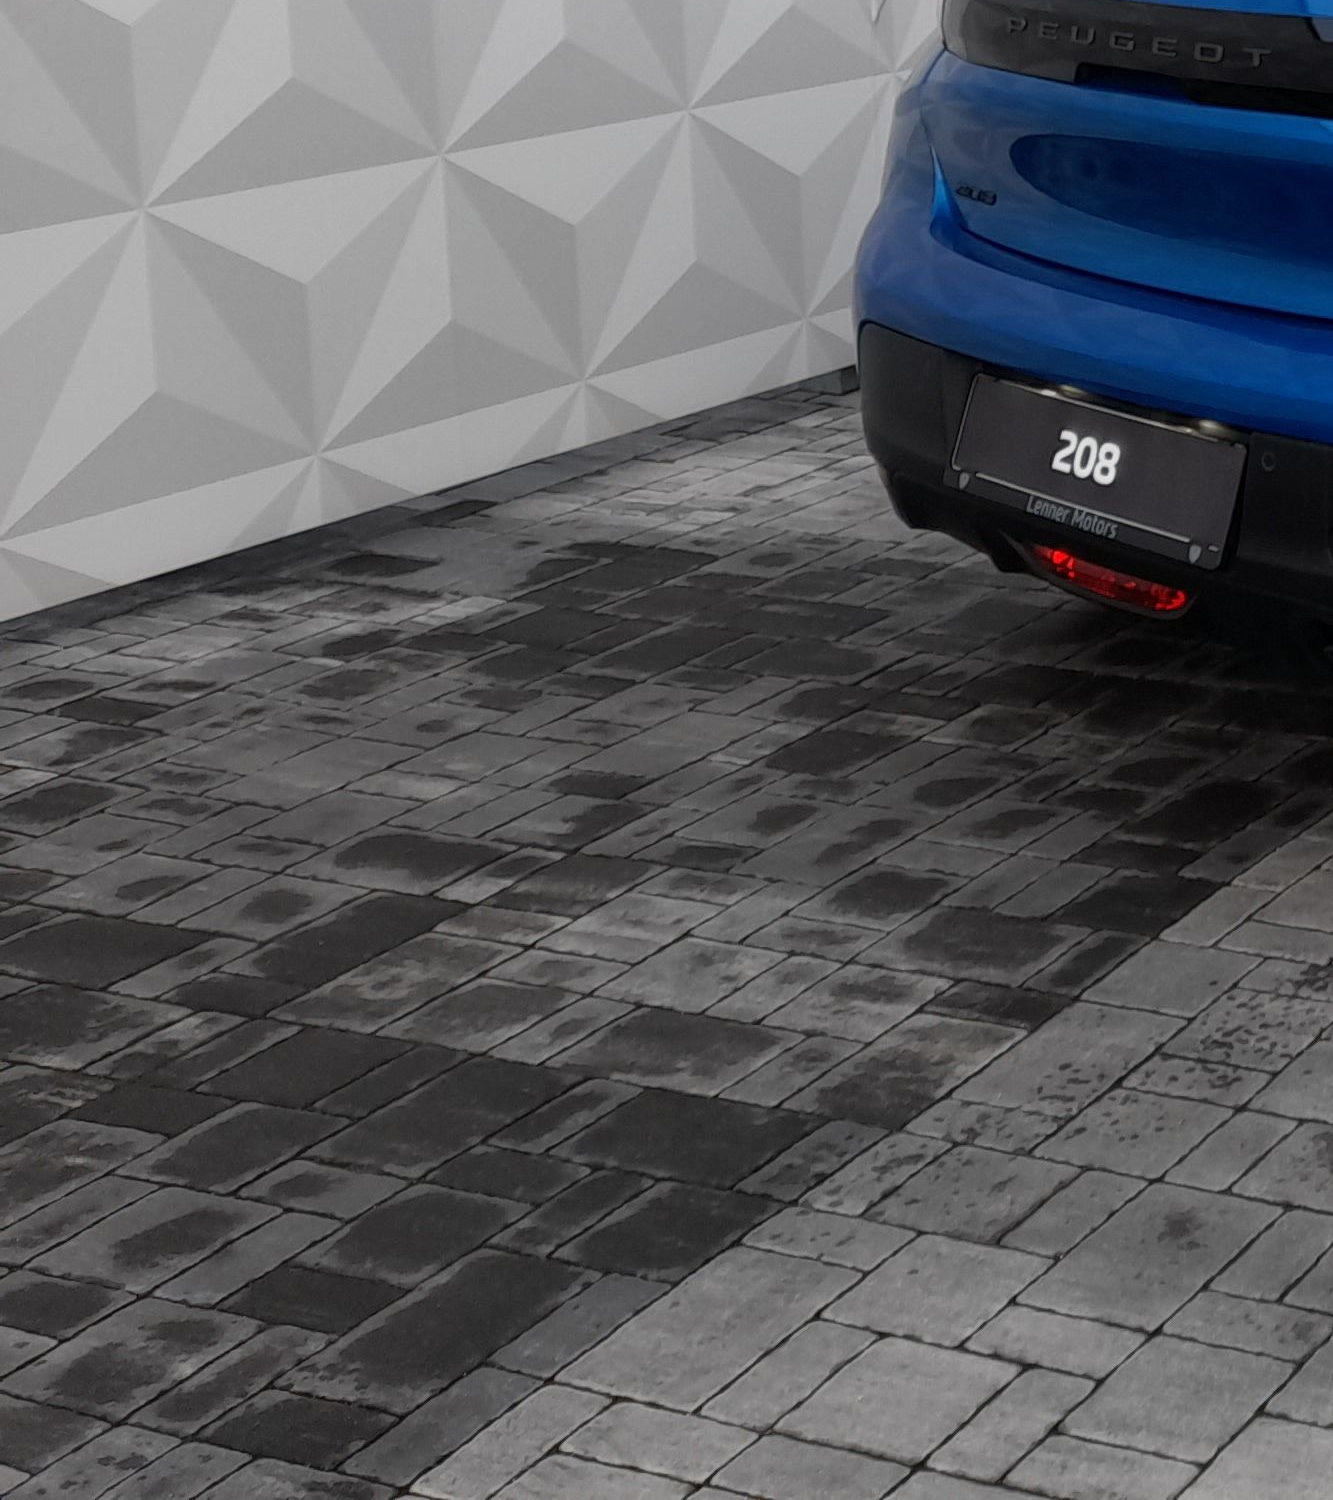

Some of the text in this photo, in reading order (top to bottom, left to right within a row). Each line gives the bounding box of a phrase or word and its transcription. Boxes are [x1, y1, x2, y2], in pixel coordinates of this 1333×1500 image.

[1006, 16, 1272, 68] PEUGEOT
[1050, 428, 1121, 487] 208
[1026, 495, 1119, 539] Lenner Motors
